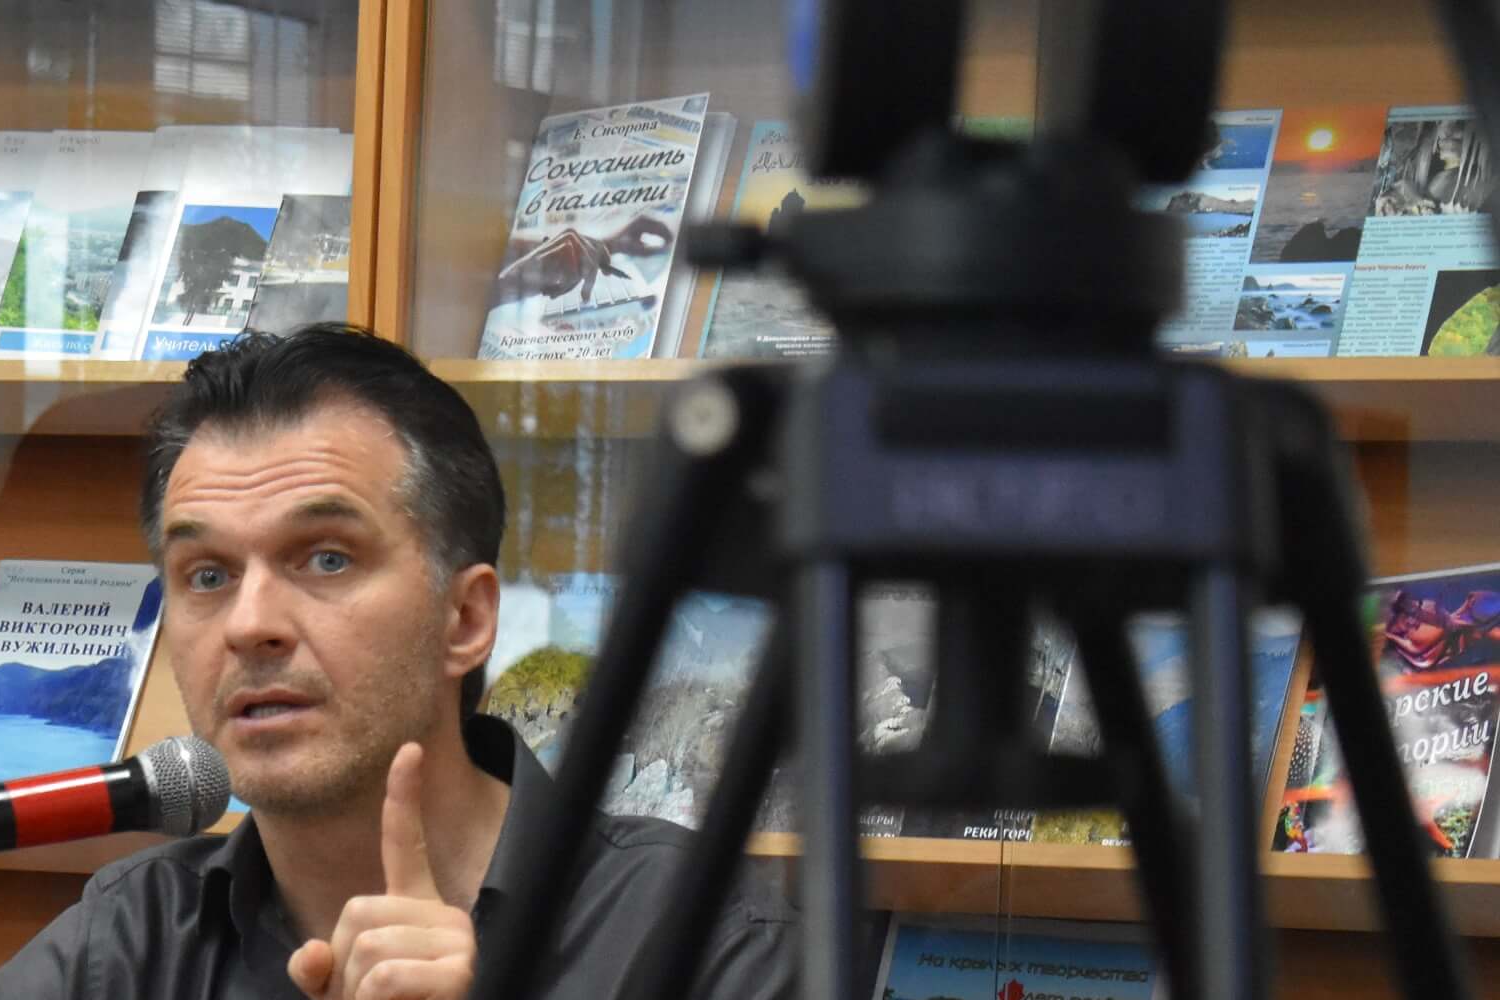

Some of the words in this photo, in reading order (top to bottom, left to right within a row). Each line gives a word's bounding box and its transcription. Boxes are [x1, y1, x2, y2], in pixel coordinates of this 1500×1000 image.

[527, 149, 686, 182] Сохранить
[525, 190, 547, 215] в
[546, 184, 669, 213] памяти
[601, 326, 635, 341] клубу
[154, 336, 216, 353] Учитель
[22, 601, 111, 617] ВАЛЕРИЙ
[0, 620, 127, 637] ВИКТОРОВИЧ
[964, 826, 998, 838] РЕКИ
